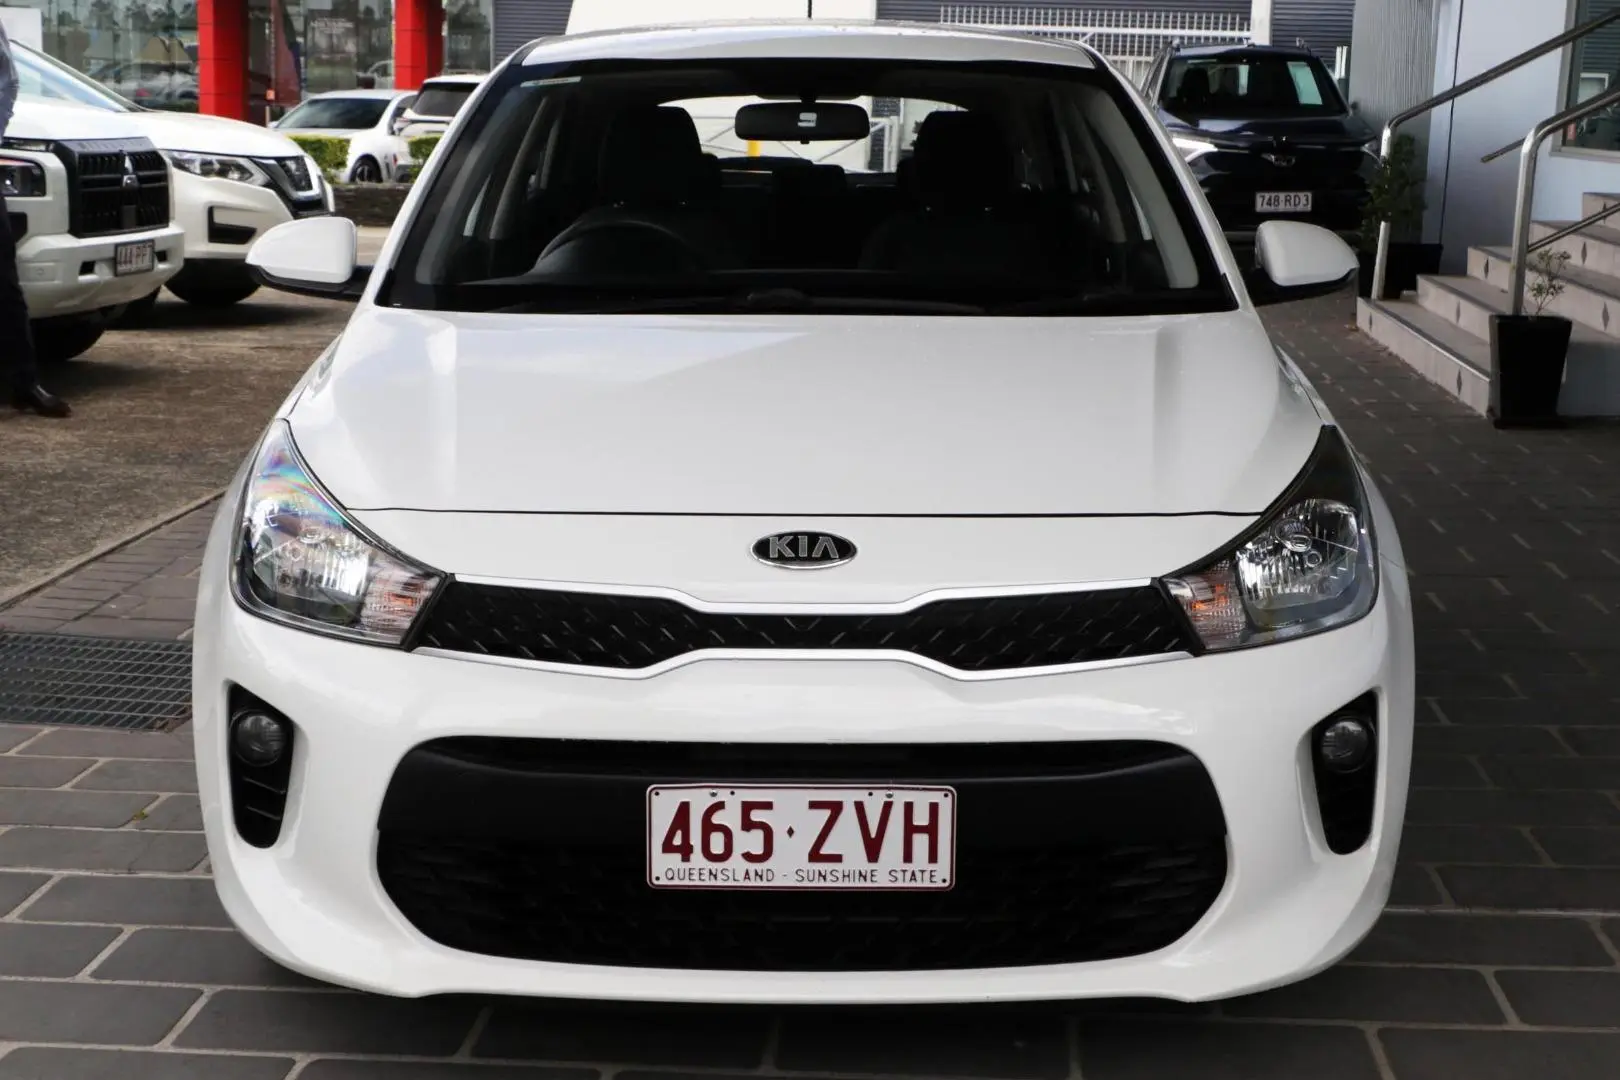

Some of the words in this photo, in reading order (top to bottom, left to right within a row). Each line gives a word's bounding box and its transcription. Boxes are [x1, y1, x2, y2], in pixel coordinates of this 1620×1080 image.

[1259, 194, 1280, 208] 748
[1284, 194, 1309, 208] RD3
[769, 535, 839, 559] KIA
[662, 801, 774, 863] 465
[808, 801, 939, 864] ZVH
[665, 867, 775, 882] QUEENSLAND
[795, 868, 878, 883] SUNSHINE
[888, 869, 937, 884] STATE
